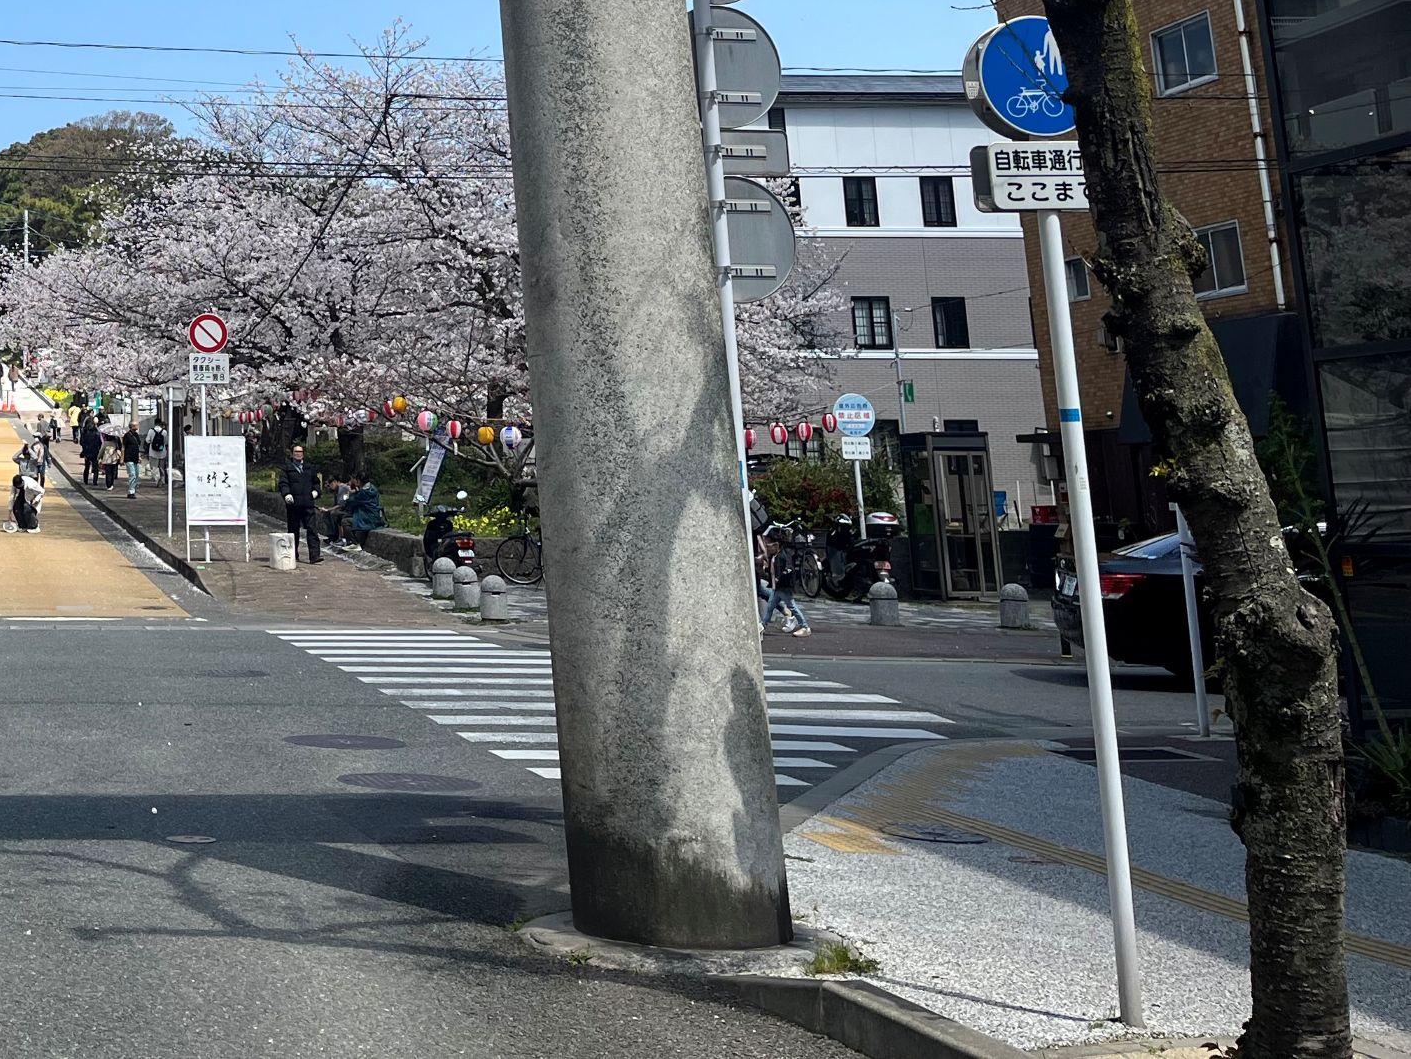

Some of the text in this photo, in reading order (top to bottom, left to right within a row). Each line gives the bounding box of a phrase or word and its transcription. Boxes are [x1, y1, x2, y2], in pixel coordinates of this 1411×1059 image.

[994, 149, 1083, 172] 自転車通行
